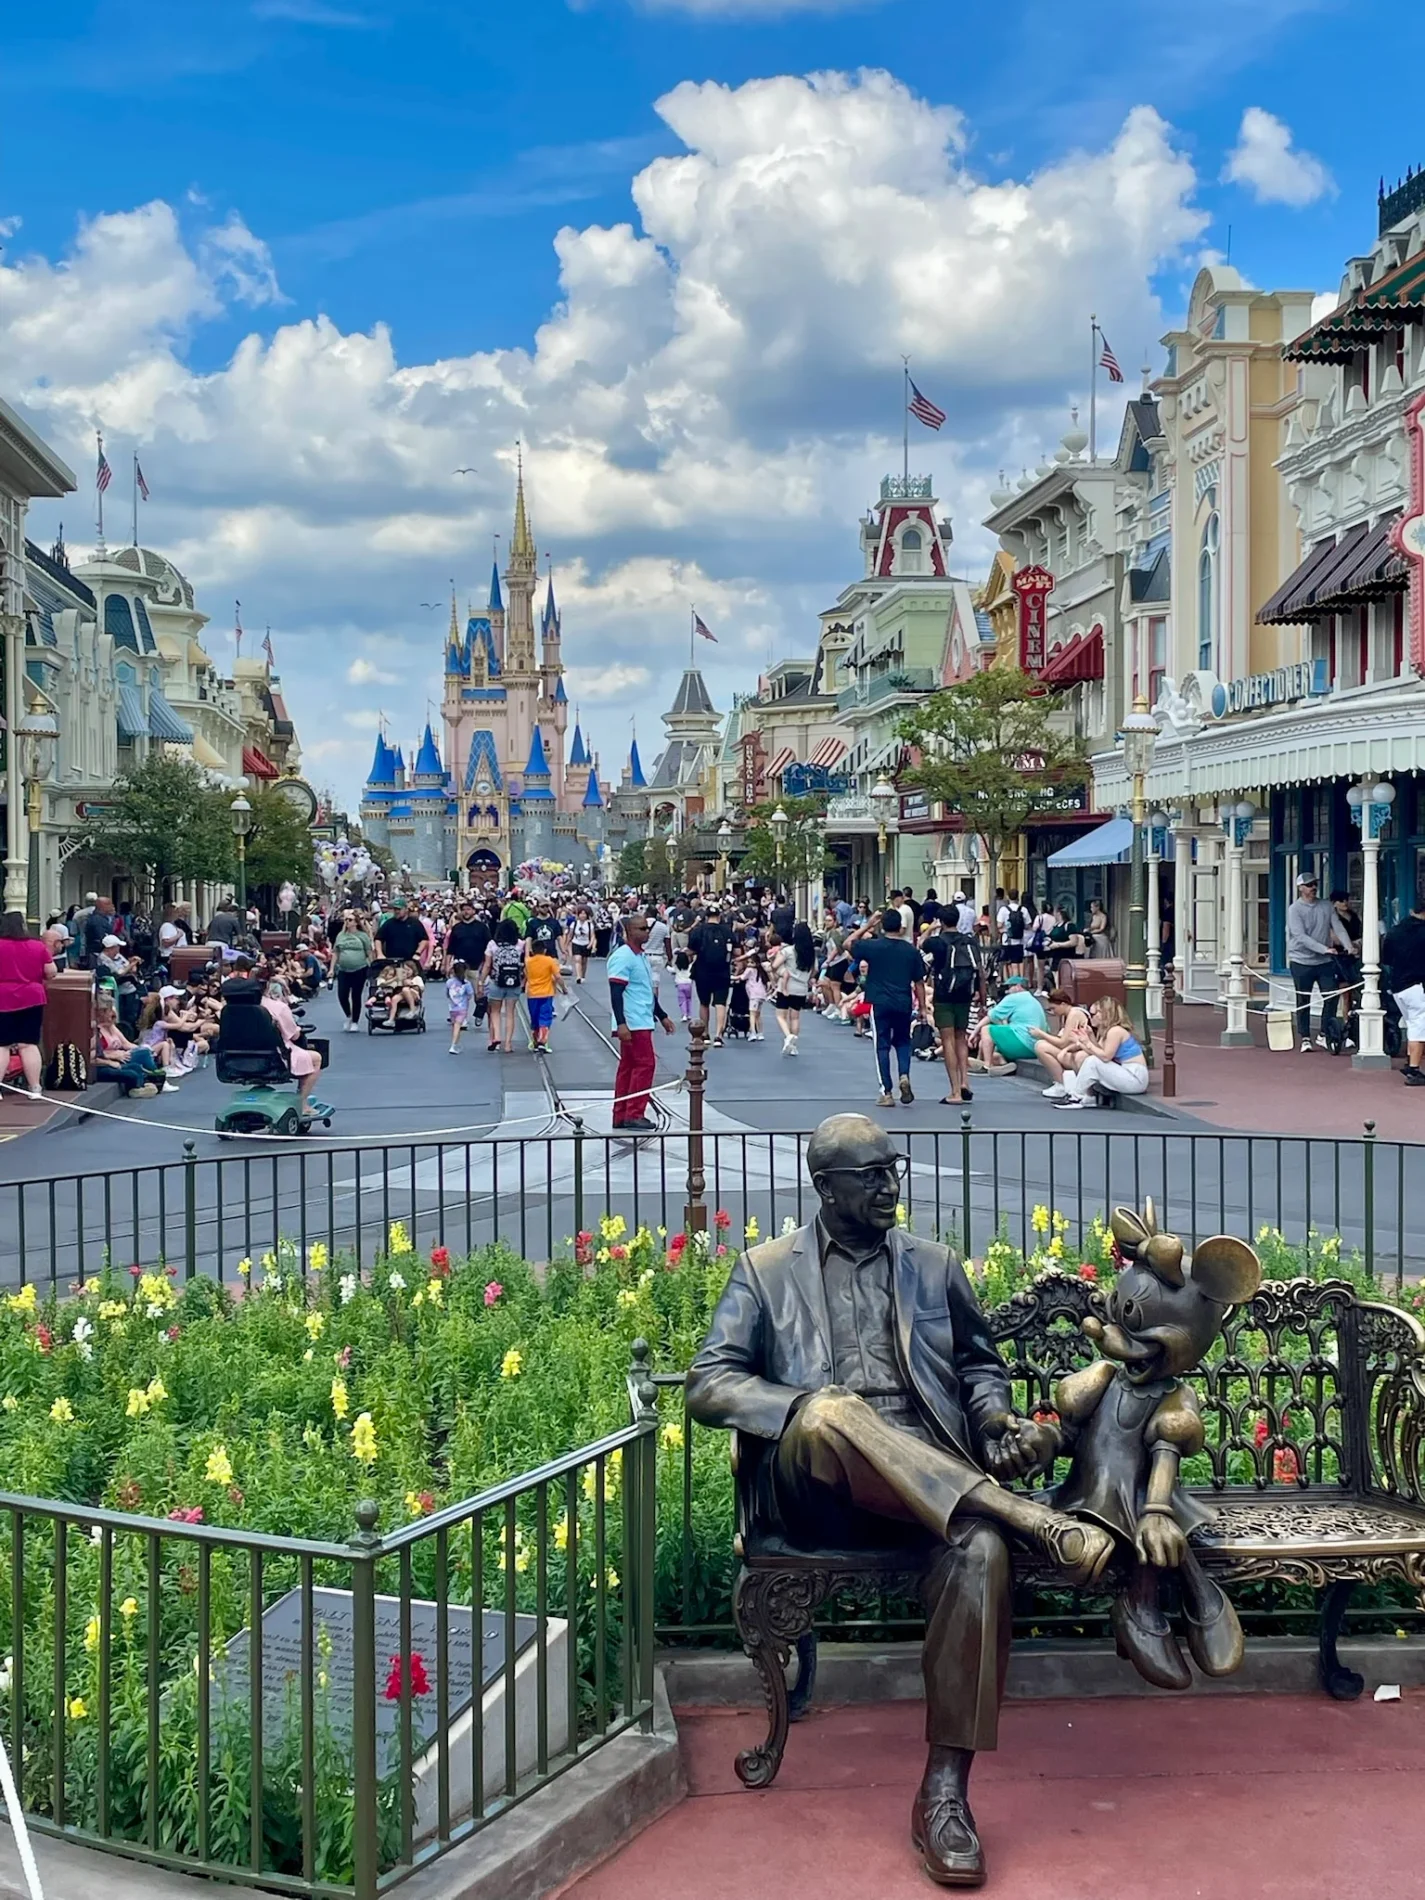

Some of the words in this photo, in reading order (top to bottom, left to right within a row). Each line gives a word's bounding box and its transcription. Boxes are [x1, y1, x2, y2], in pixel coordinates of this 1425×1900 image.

[1016, 574, 1049, 587] MAIN
[1025, 593, 1043, 680] CINEMA
[1227, 660, 1316, 713] CONFECTIONERY
[311, 1607, 351, 1621] ALT
[429, 1624, 499, 1641] ORD
